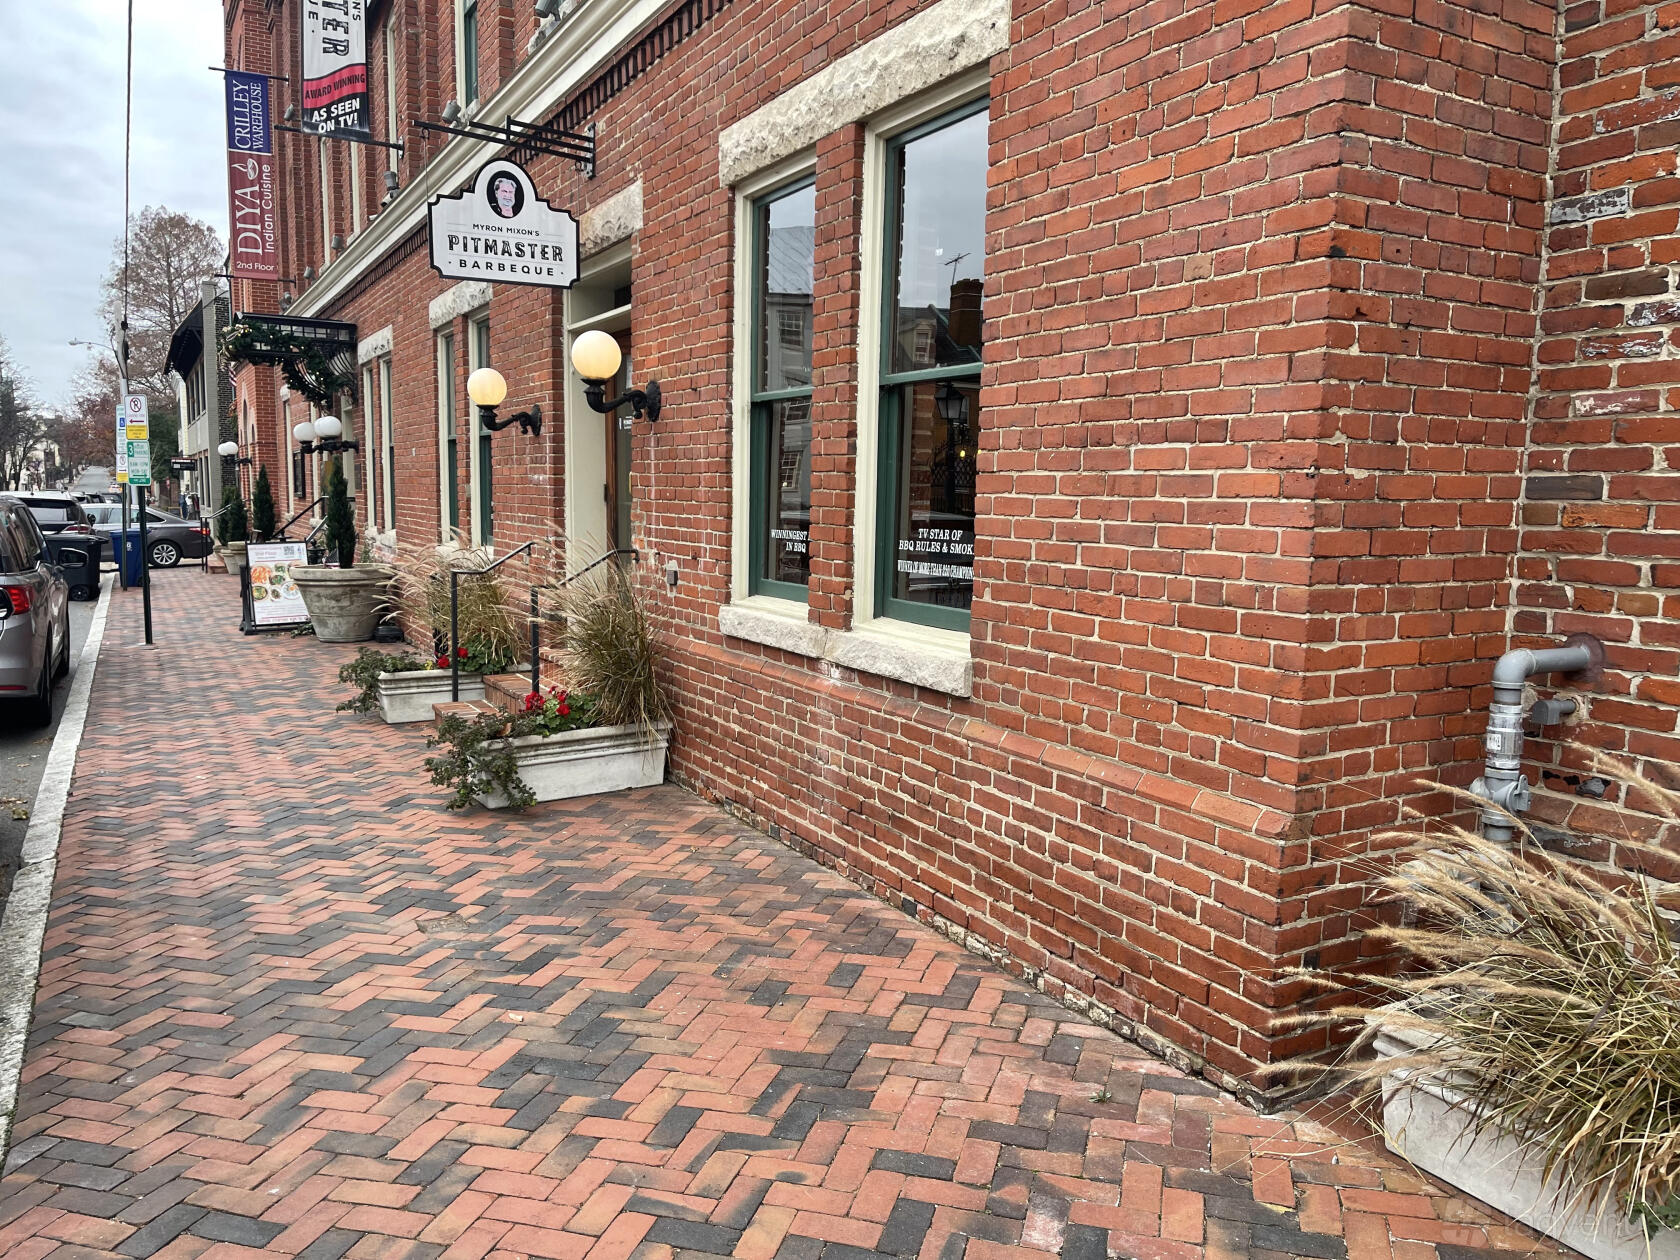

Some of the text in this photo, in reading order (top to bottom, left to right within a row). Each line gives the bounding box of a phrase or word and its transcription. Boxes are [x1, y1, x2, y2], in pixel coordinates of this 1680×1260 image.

[305, 73, 365, 100] AWARD WINNING
[232, 79, 251, 149] CRILLEY
[250, 82, 264, 149] WAREHOUSE
[311, 97, 360, 123] AS SEEN
[318, 112, 358, 134] ON TV!
[260, 164, 275, 253] Indian Cuisine
[234, 184, 263, 256] DIYA
[472, 223, 540, 237] MYRON MIXON'S
[447, 234, 564, 262] PITMASTER
[236, 261, 275, 271] 2nd Floor
[459, 259, 554, 276] BARBEQUE
[128, 444, 134, 456] 3
[770, 529, 808, 541] WINNINGEST
[918, 528, 963, 541] TV STAR OF
[785, 541, 807, 553] IN BBQ
[898, 540, 975, 556] BBQ RULES & SMOK
